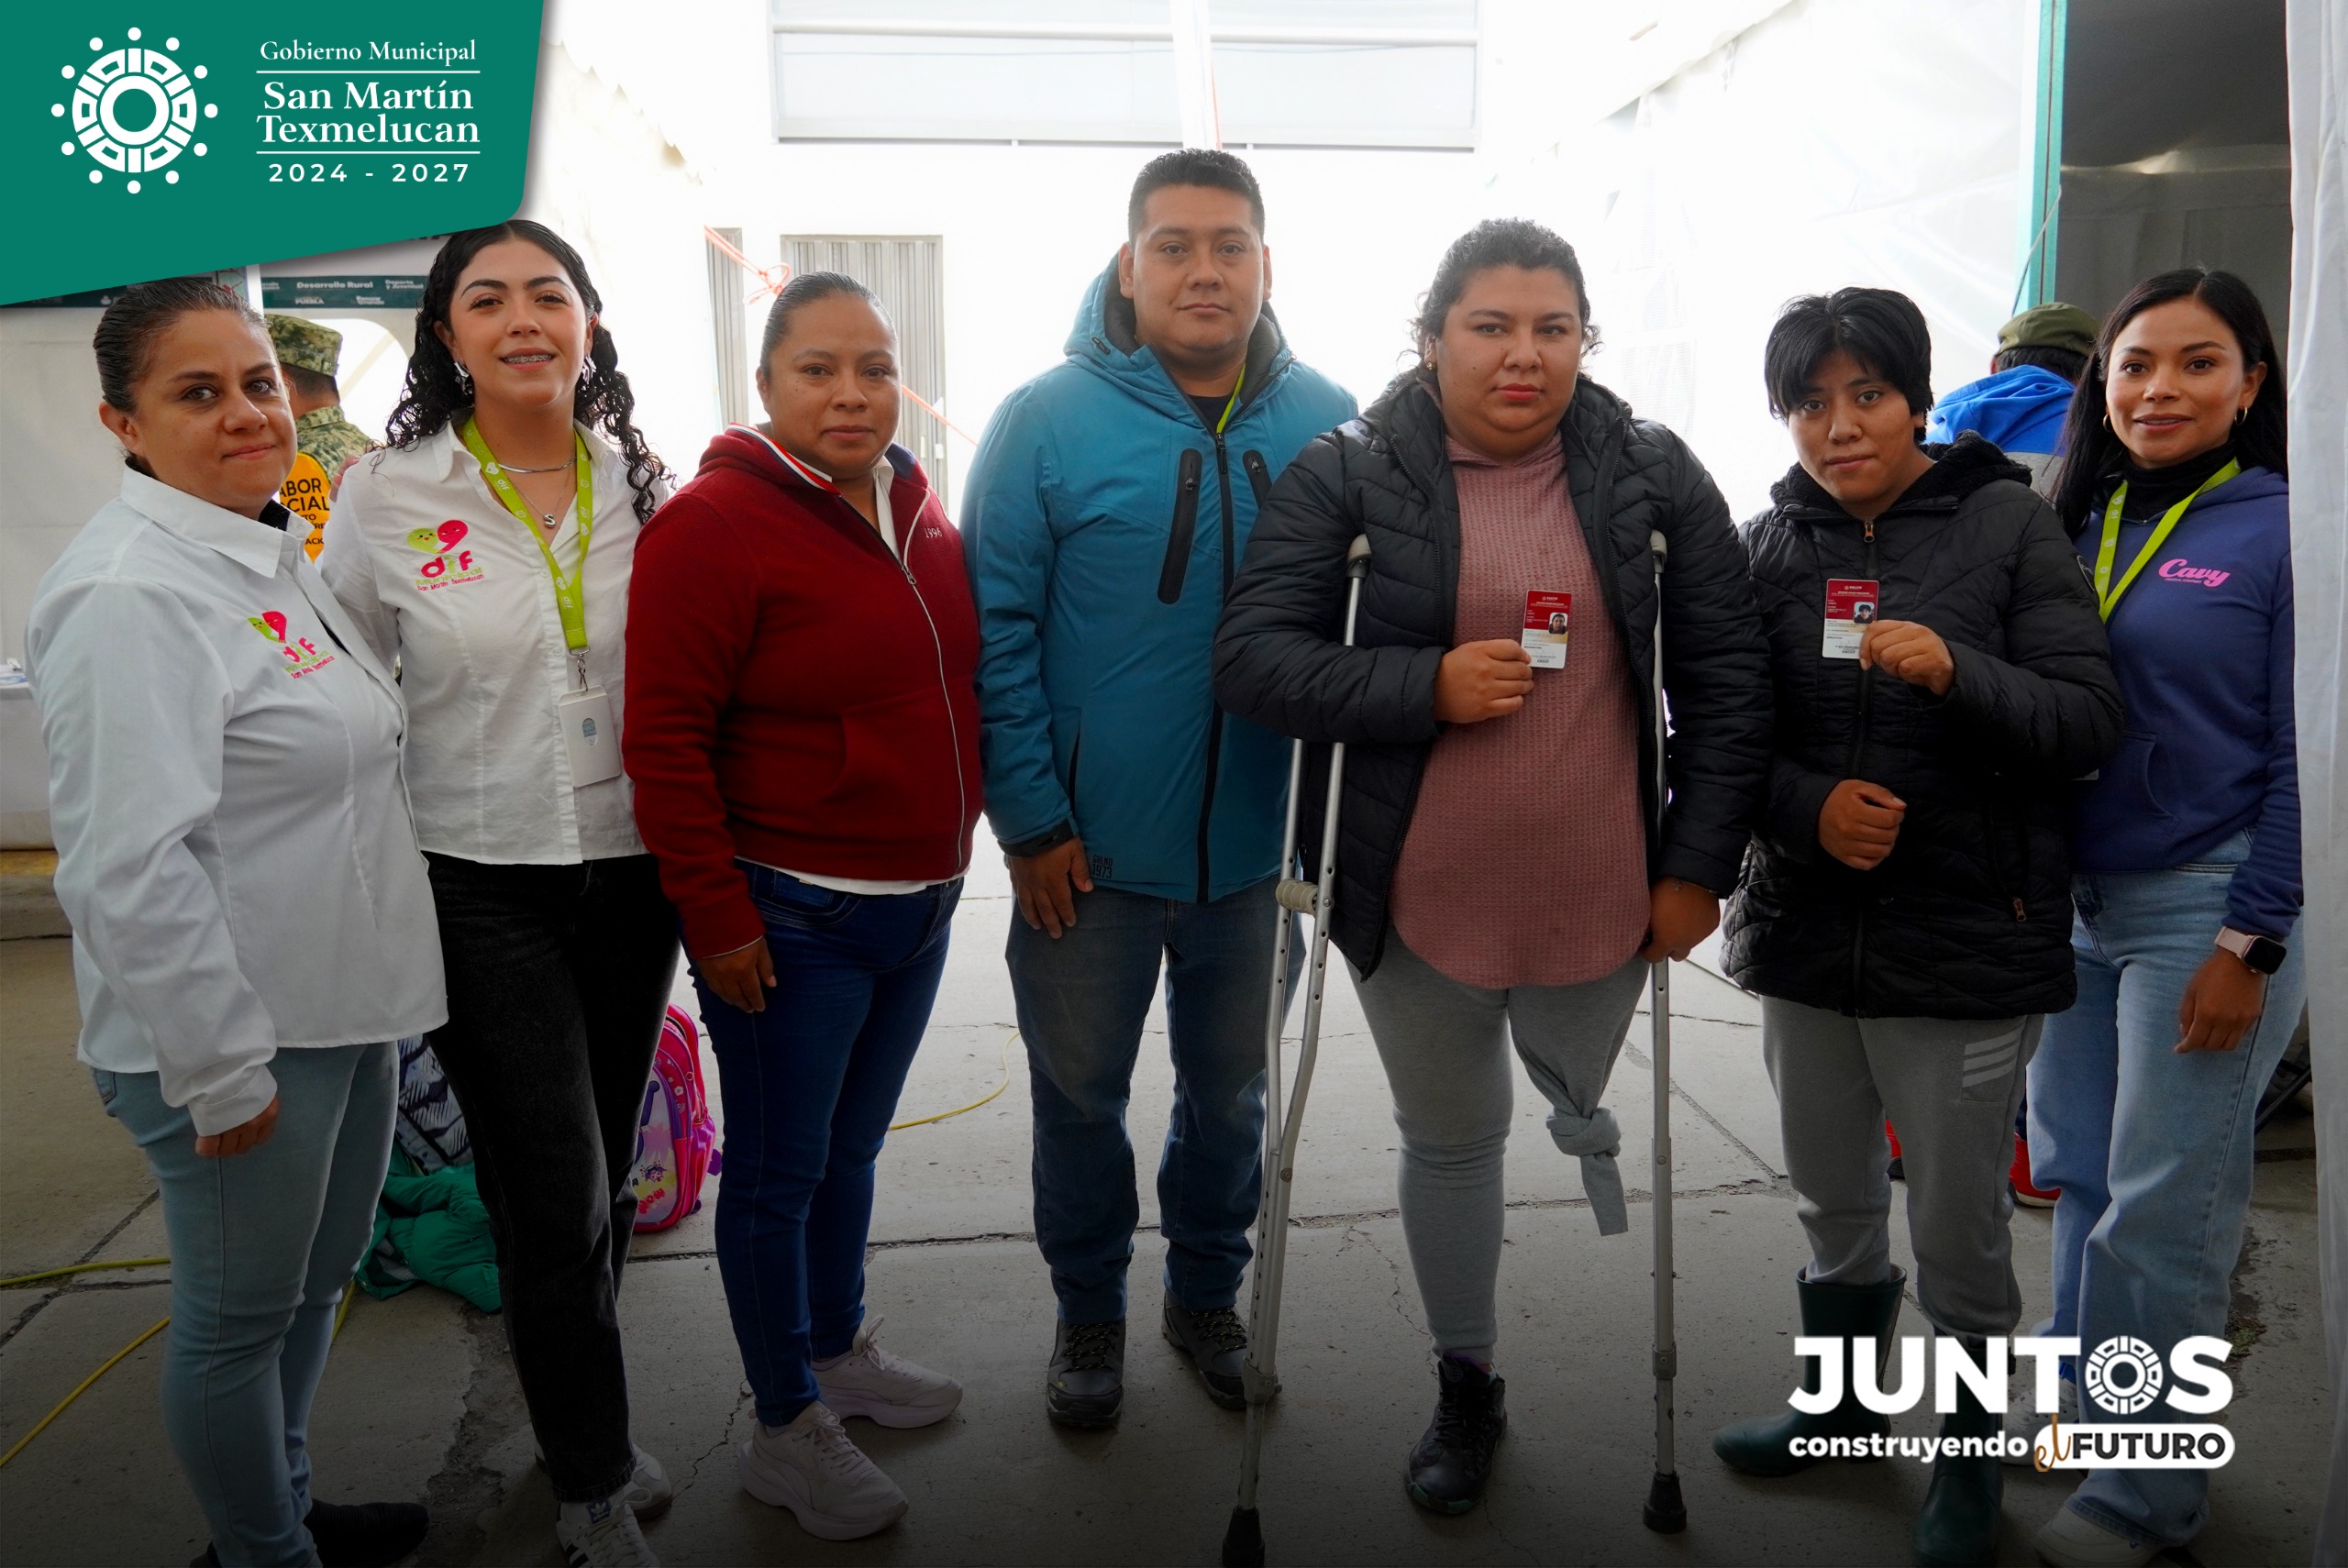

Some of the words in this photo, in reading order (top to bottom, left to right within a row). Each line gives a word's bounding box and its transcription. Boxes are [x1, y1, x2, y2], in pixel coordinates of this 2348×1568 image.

[347, 281, 373, 289] Rural
[280, 479, 321, 497] ABOR
[287, 496, 329, 513] CIAL
[925, 527, 943, 538] 1996
[421, 550, 473, 579] dif
[2158, 558, 2231, 588] Cavy
[1092, 864, 1113, 878] 1973
